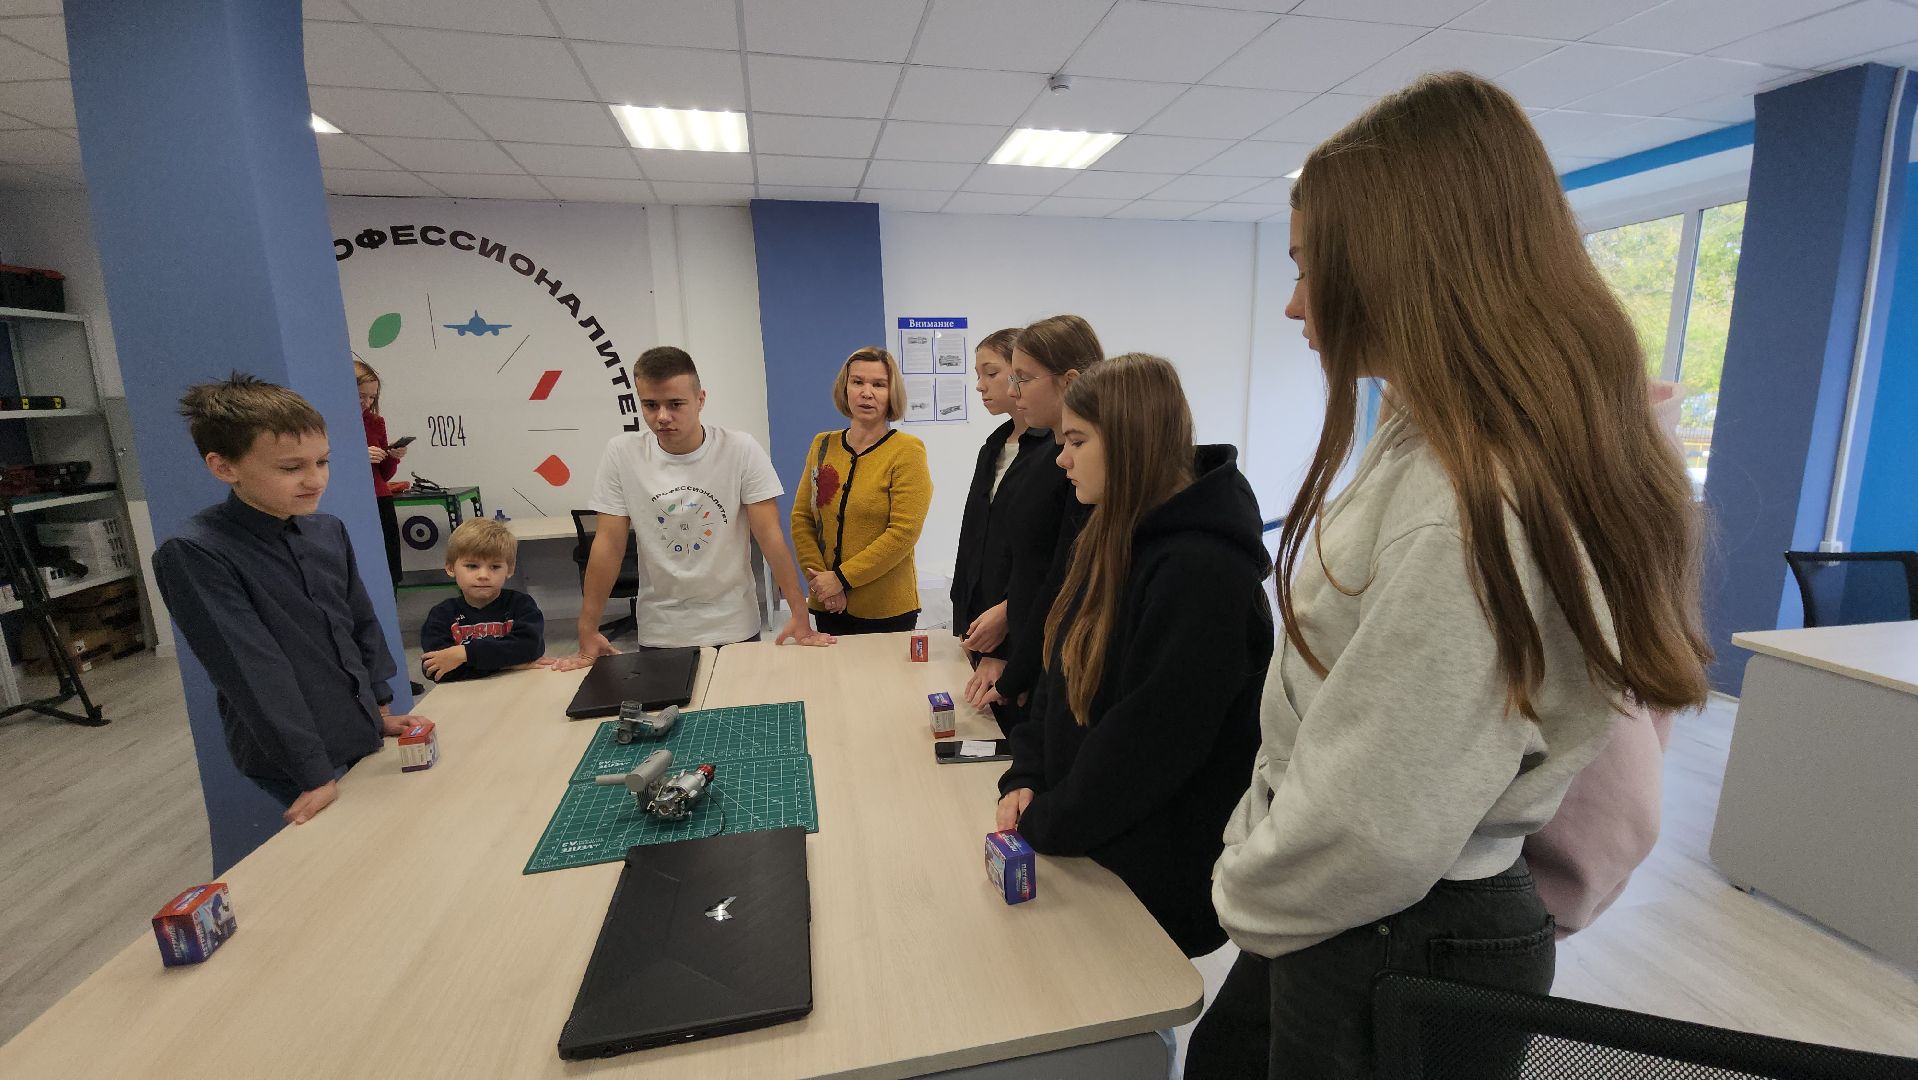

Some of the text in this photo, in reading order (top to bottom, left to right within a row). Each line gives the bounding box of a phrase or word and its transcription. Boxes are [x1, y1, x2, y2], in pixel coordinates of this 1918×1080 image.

[333, 224, 640, 433] ОФЕССИОНАЛИТЕТ
[909, 319, 955, 328] Внимание
[427, 415, 467, 447] 2024
